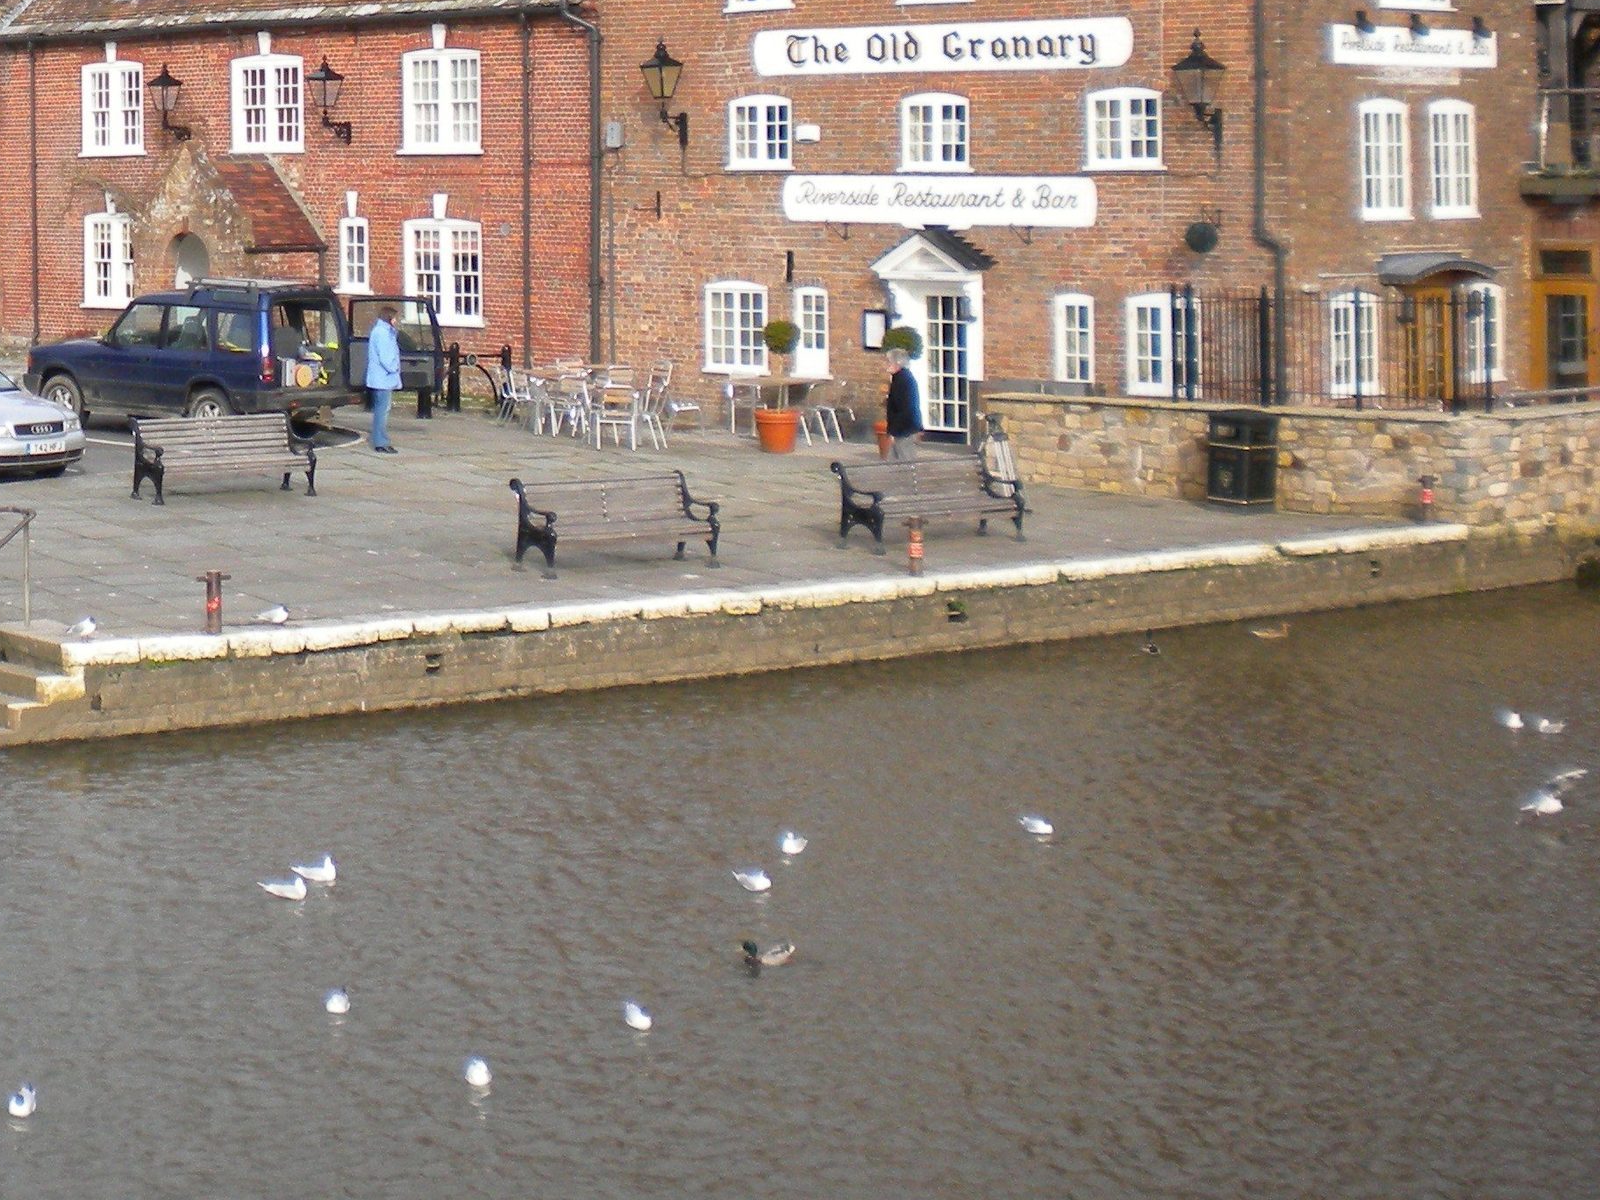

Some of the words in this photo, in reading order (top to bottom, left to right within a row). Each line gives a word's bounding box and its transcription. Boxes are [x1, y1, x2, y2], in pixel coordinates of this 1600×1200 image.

[786, 34, 850, 68] The
[866, 30, 920, 64] Old
[942, 30, 1099, 66] Granary
[796, 180, 880, 207] Riverside
[887, 181, 1006, 208] Restaurant
[1011, 187, 1026, 209] &
[1031, 183, 1079, 209] Bar
